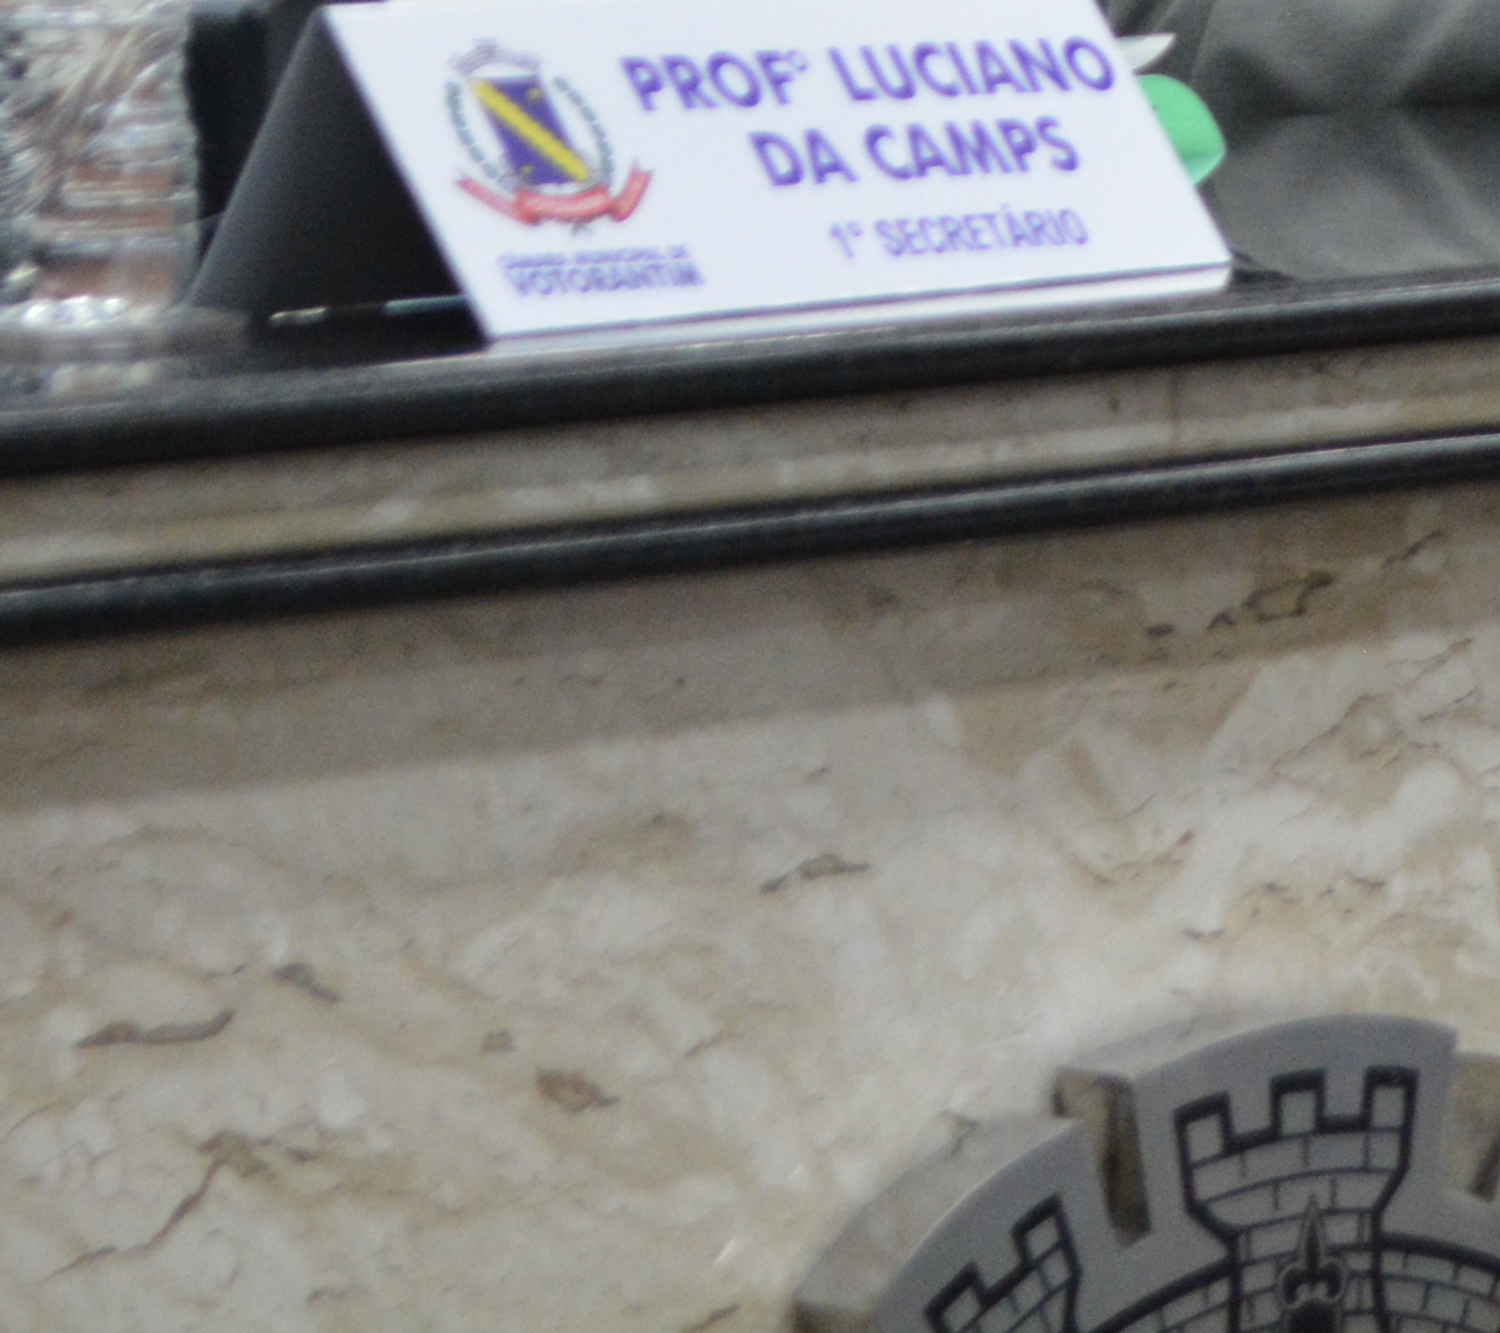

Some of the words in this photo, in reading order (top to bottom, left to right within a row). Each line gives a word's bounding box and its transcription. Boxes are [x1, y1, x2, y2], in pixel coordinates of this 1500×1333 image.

[826, 35, 1115, 102] LUCIANO
[748, 128, 858, 187] DA
[863, 115, 1080, 181] CAMPS
[873, 203, 1089, 257] SECRETÁRIO
